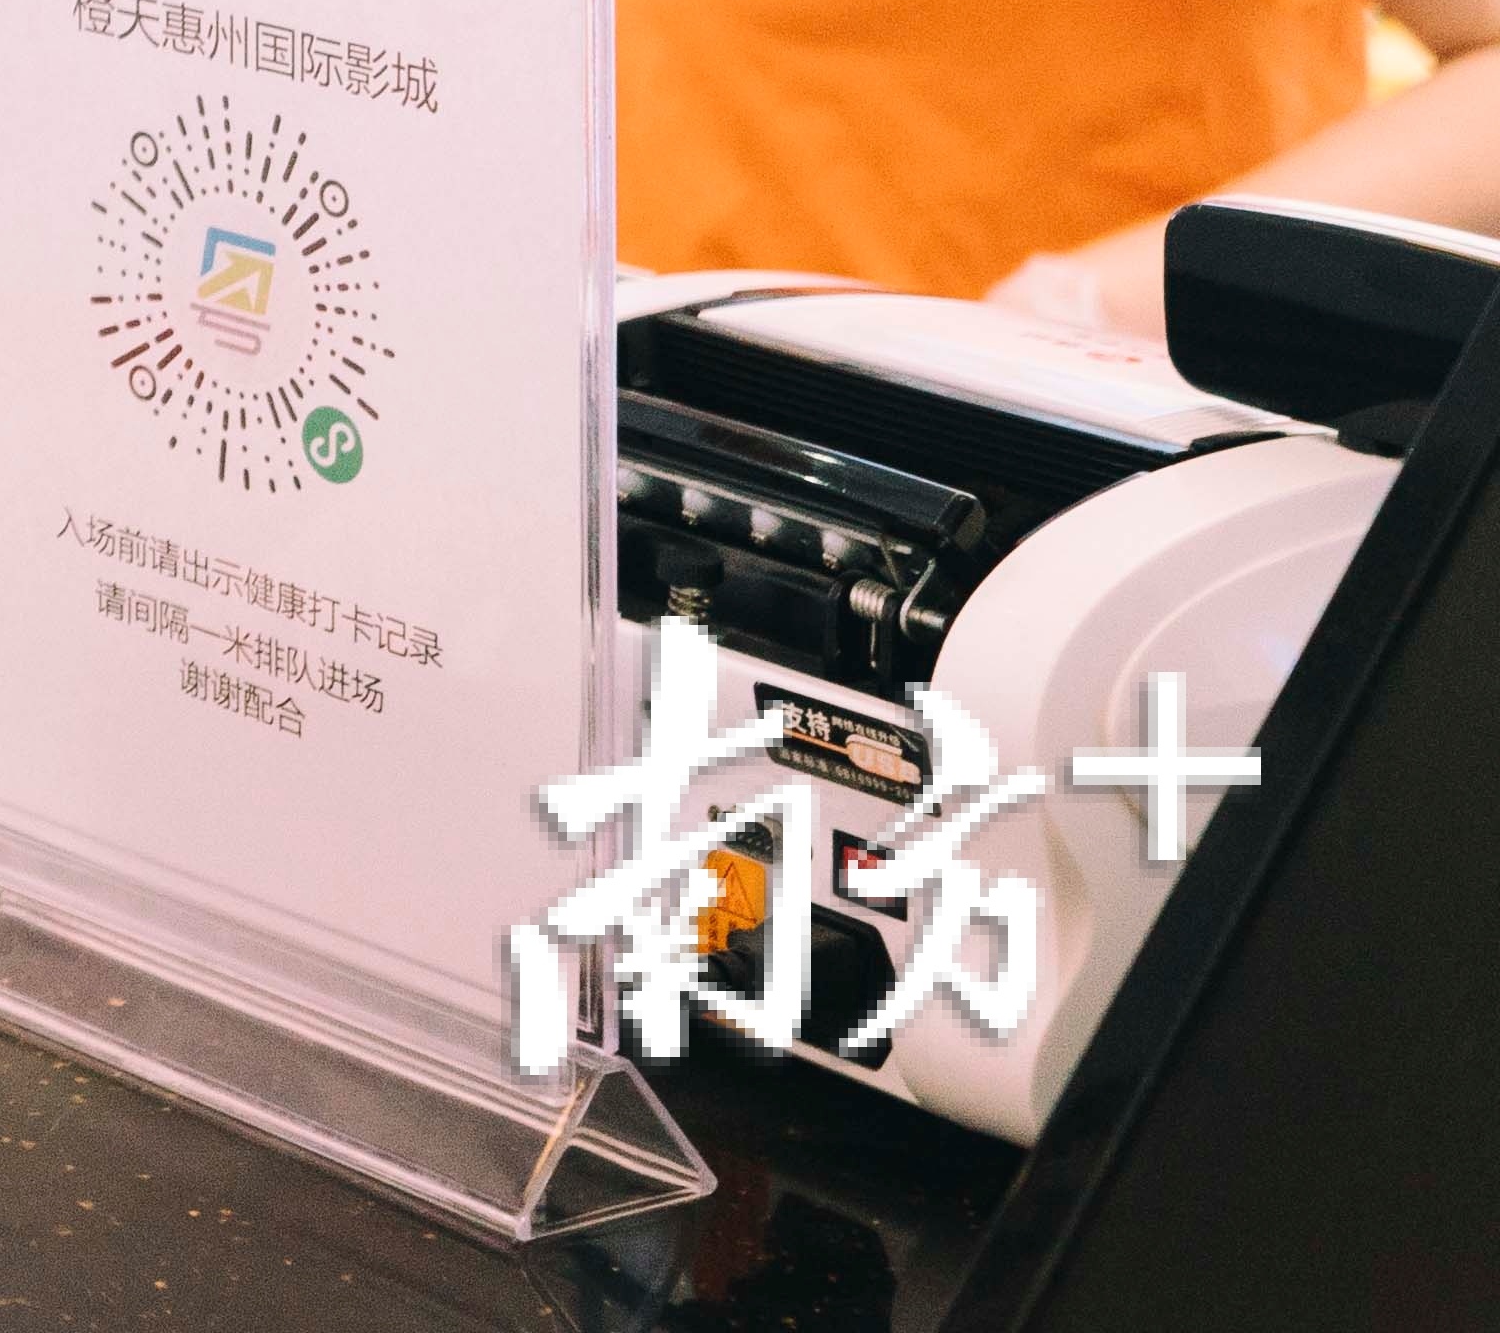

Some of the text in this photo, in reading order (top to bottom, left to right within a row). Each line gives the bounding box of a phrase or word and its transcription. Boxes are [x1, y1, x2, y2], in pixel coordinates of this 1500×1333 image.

[56, 505, 444, 669] 入场前请出示健康打卡记录
[95, 578, 385, 715] 请间隔一米排队进场
[178, 656, 307, 739] 谢谢配合
[781, 702, 831, 742] 支持
